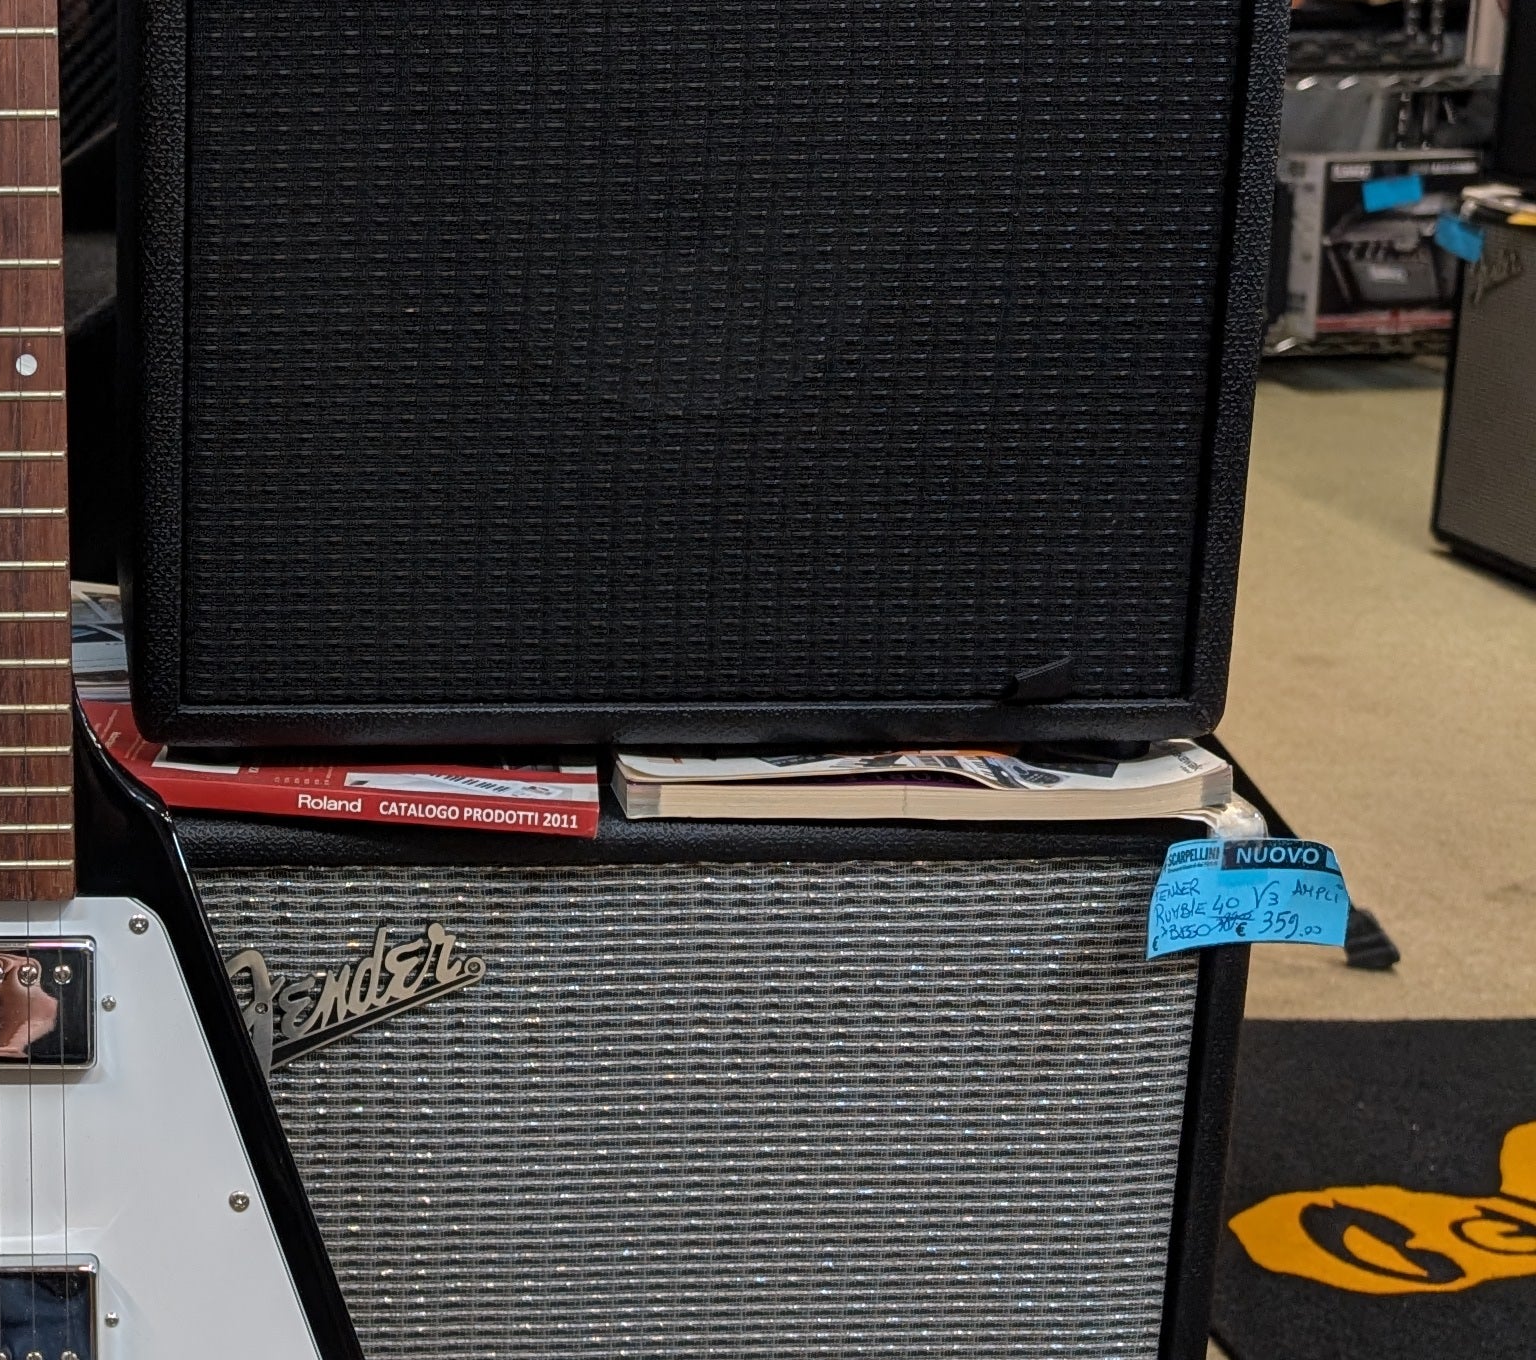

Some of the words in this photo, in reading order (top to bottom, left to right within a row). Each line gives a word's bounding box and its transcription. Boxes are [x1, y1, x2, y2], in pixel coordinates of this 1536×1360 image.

[297, 794, 362, 813] Roland
[379, 801, 460, 821] CATALOGO
[463, 806, 540, 827] PRODOTTI
[542, 812, 579, 829] 2011
[1236, 846, 1320, 865] NUOVO
[1212, 895, 1240, 914] 40
[225, 922, 485, 1080] Fender
